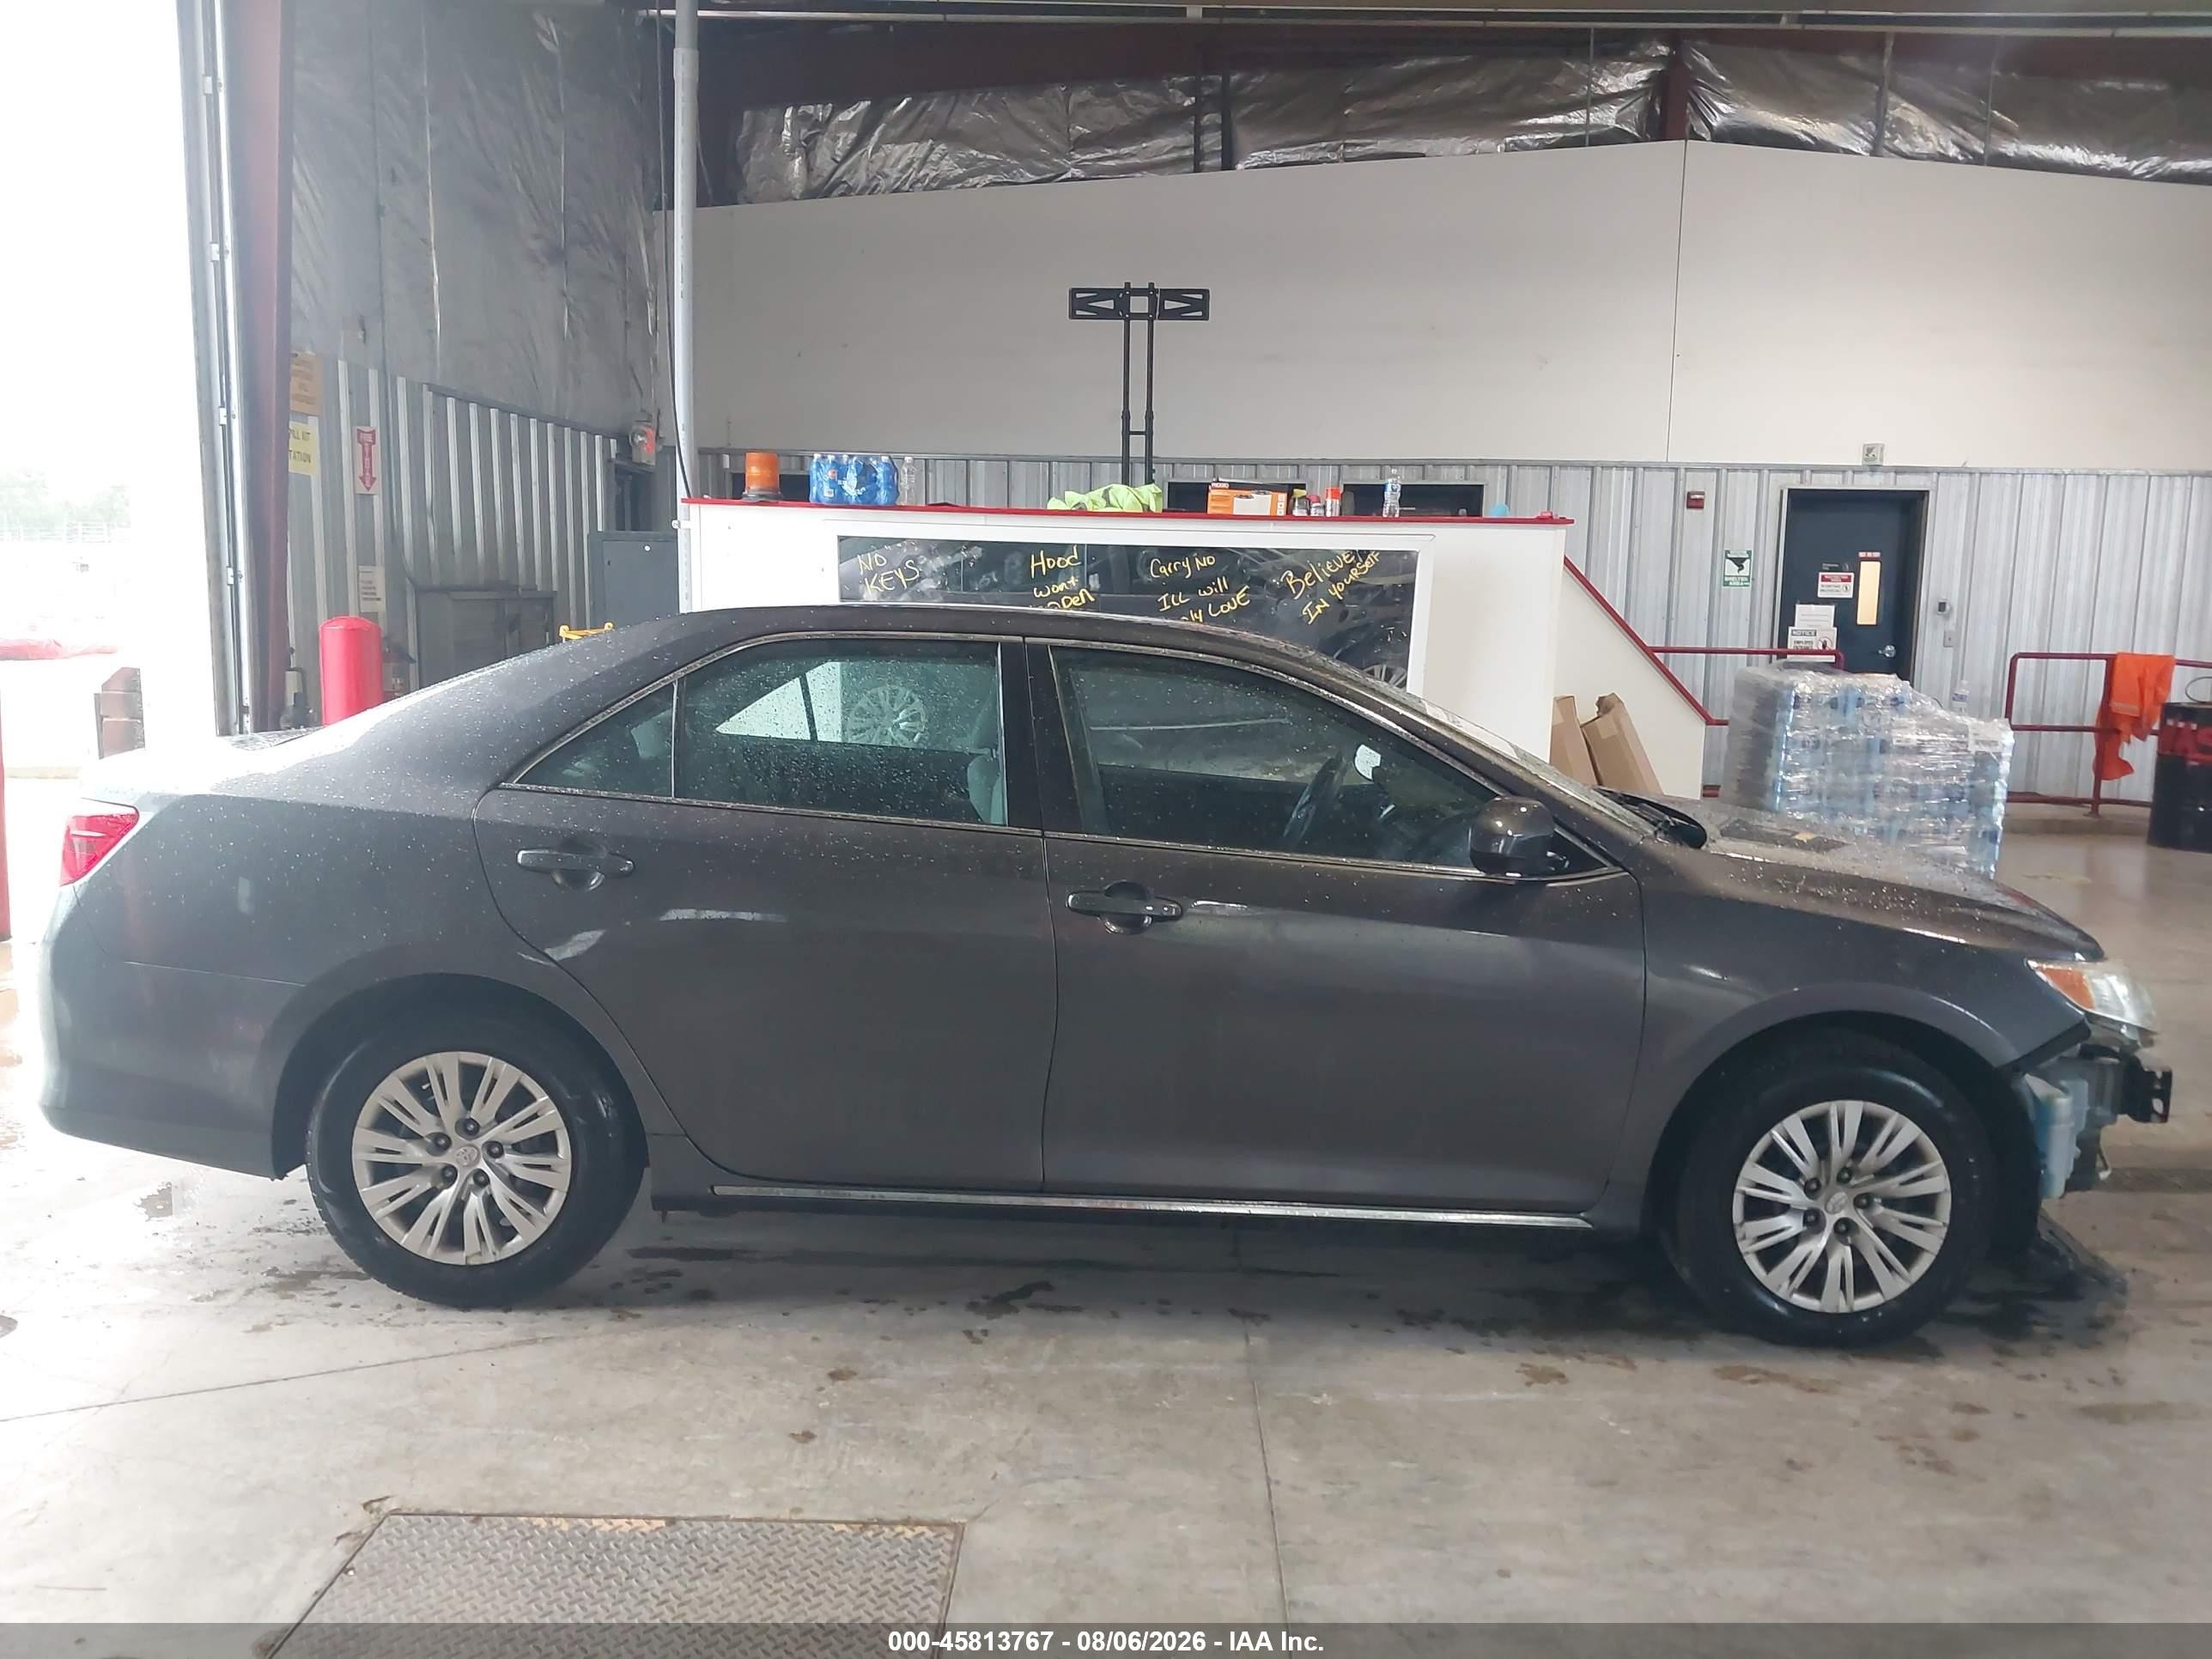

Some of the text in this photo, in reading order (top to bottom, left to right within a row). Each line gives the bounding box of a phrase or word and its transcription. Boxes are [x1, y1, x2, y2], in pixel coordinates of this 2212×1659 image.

[289, 449, 312, 464] TATION
[858, 552, 887, 575] NO
[1030, 544, 1082, 579] Hood
[1151, 558, 1192, 579] Carry
[864, 559, 920, 595] KEYS
[1198, 575, 1229, 597] will
